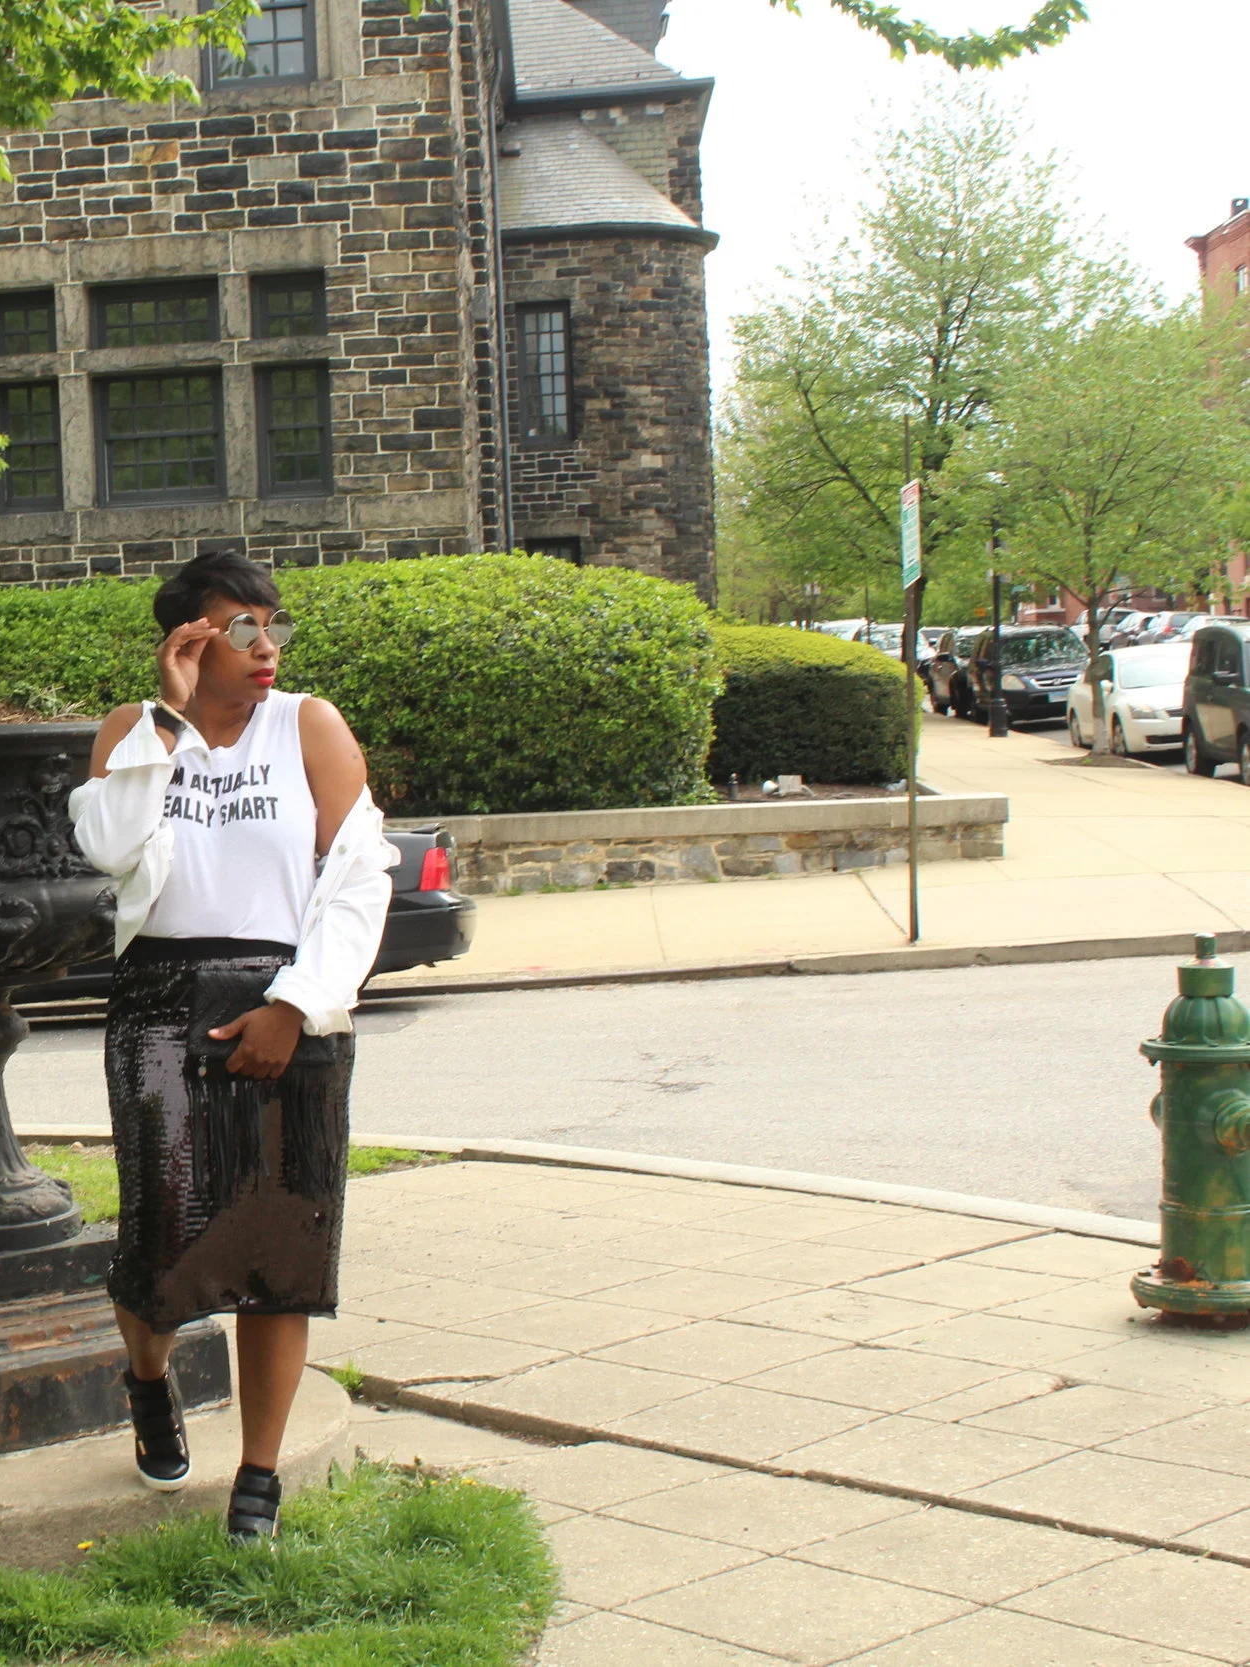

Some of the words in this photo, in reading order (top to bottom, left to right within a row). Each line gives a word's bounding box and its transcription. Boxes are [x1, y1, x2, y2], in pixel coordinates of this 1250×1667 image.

[170, 766, 185, 786] M
[163, 795, 215, 828] EALLY
[220, 796, 278, 826] SMART
